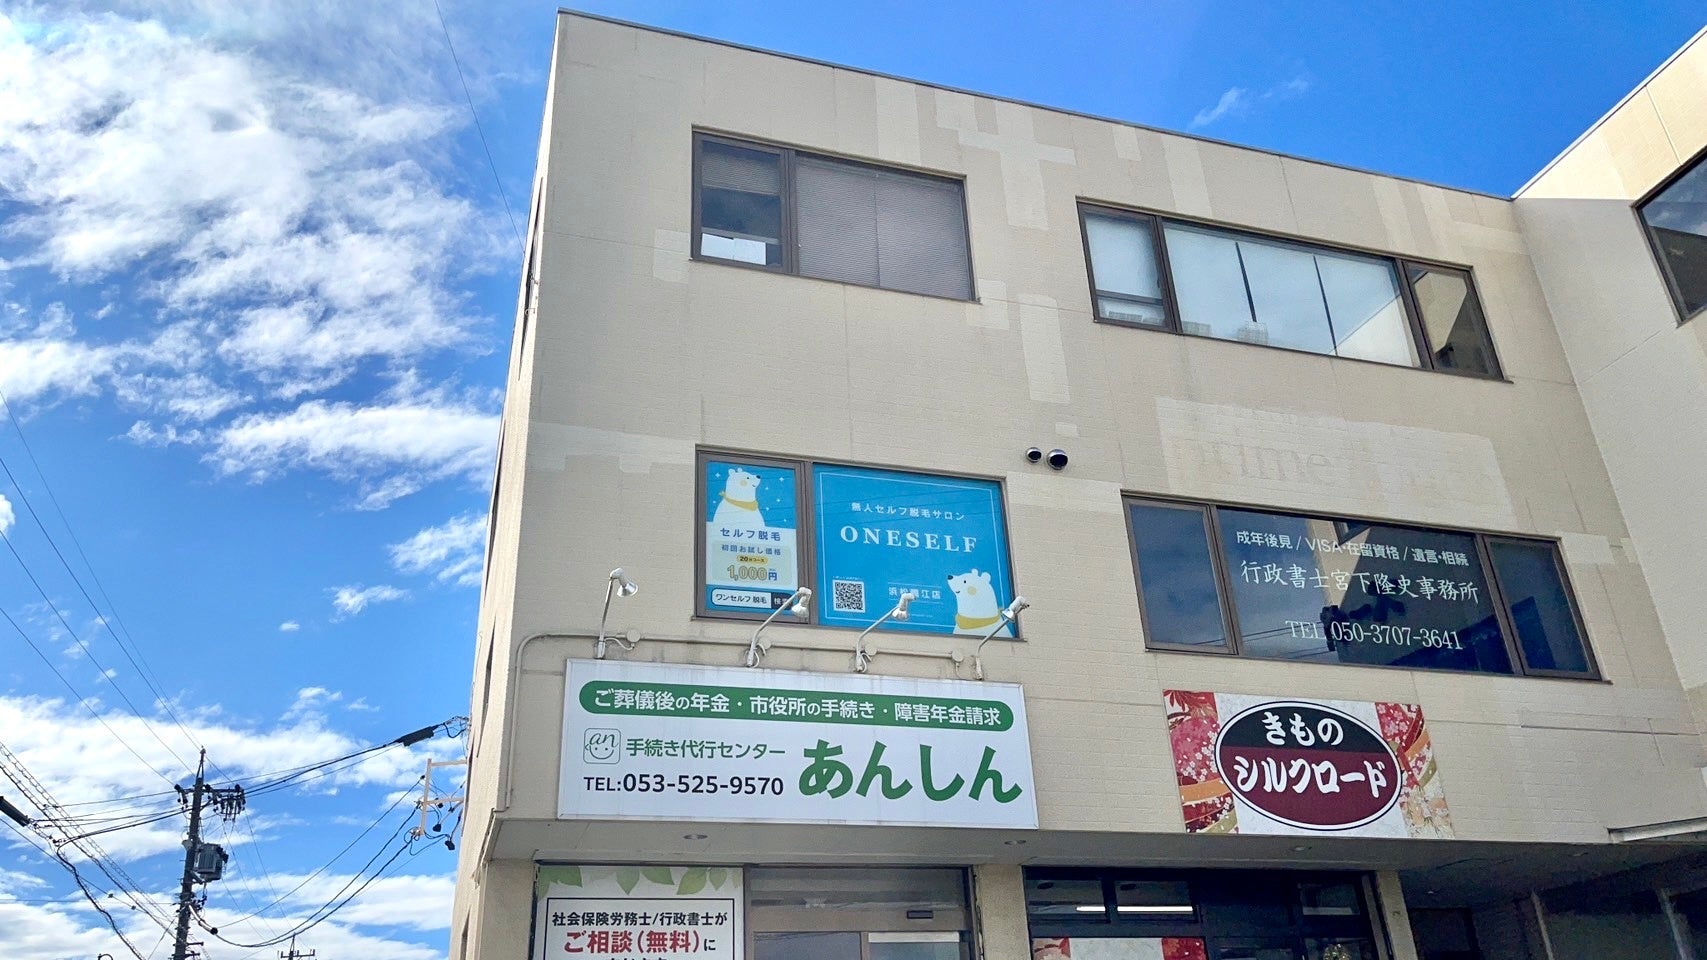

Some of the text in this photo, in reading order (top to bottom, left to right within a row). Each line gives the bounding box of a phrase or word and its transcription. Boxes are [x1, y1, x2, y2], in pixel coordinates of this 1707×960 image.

[851, 502, 965, 521] 無人セルフ脱毛サロン
[720, 527, 781, 541] セルフ脱毛
[840, 525, 977, 553] ONESELF
[721, 544, 781, 556] 初回お試し価格
[727, 564, 777, 581] 1,000円
[1240, 560, 1479, 604] 行政書士宮下隆史事務所
[1331, 621, 1464, 650] 050-3707-3641
[1262, 711, 1345, 747] きもの
[626, 736, 786, 760] 手続き代行センター
[798, 739, 1022, 804] あんしん
[1233, 755, 1388, 798] シルクロード
[552, 911, 728, 926] 社会保険労務士/行政書士が
